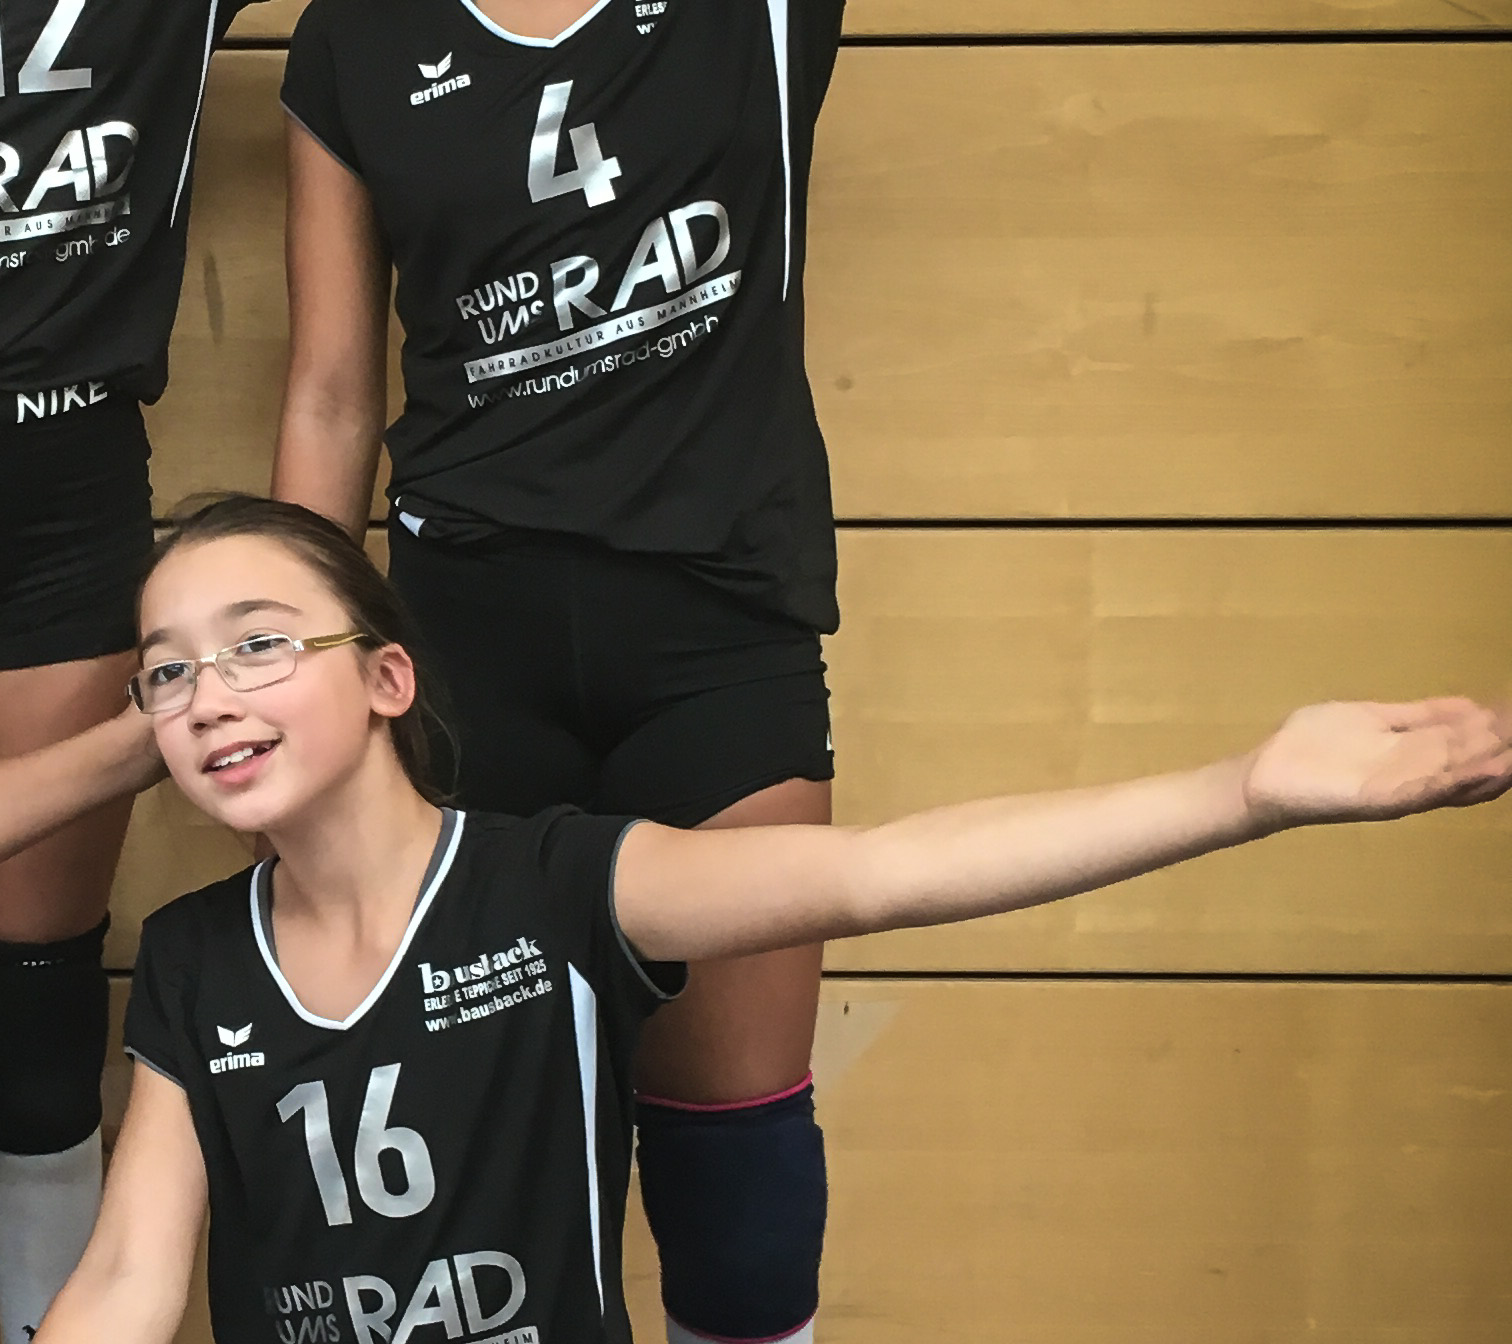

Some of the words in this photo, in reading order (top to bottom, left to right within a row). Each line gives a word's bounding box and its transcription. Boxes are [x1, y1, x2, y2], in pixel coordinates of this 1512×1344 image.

[410, 74, 471, 106] erima
[528, 80, 622, 207] 4
[24, 219, 54, 233] AUS
[550, 200, 731, 331] RAD
[456, 271, 539, 320] RUND
[477, 300, 545, 345] UMS
[469, 330, 605, 376] FAHRRADKULTUR
[615, 316, 646, 333] AUS
[656, 277, 740, 320] MANNHEIM
[16, 381, 108, 424] NIKE
[418, 936, 543, 994] busack
[424, 988, 463, 1012] ERLEE
[501, 967, 524, 986] SEIT
[524, 958, 547, 977] 1925
[425, 978, 553, 1032] ww.bausback.de
[210, 1051, 265, 1074] erima
[276, 1062, 435, 1226] 16
